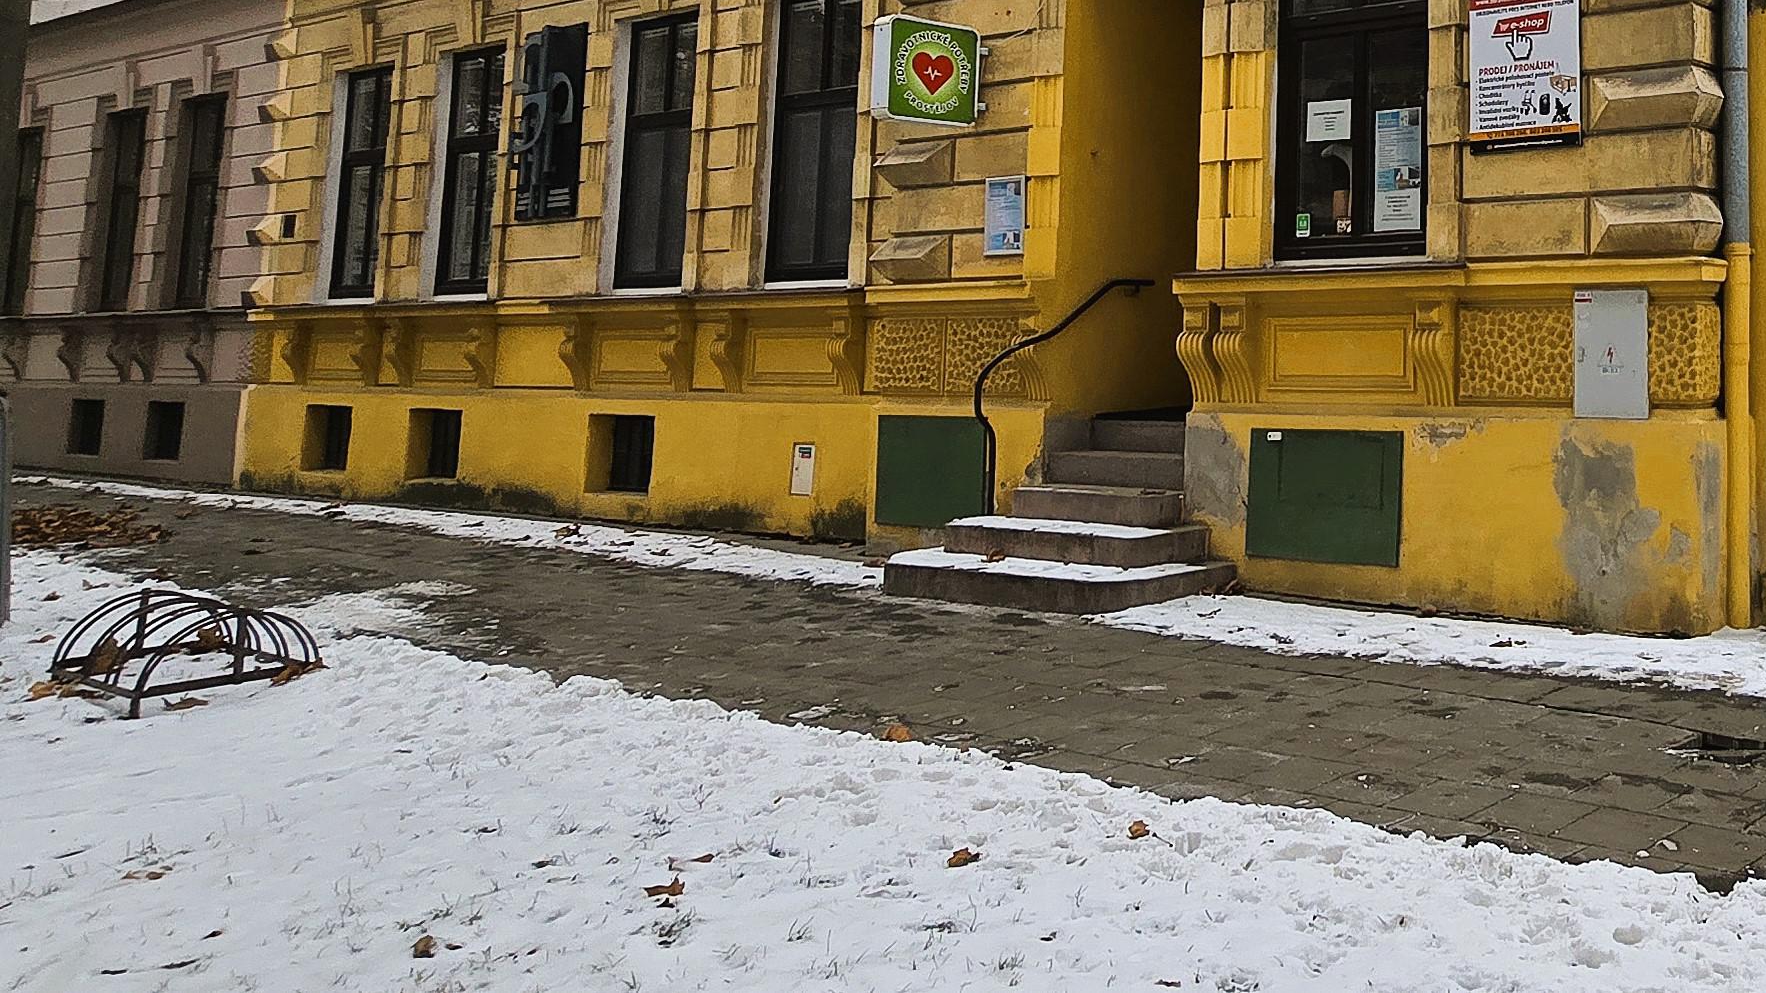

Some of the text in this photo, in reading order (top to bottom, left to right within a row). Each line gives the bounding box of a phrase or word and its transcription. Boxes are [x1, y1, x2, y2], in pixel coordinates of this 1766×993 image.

[1510, 18, 1544, 30] e-shop
[896, 32, 970, 93] ZDRAVOTNICKÉ POTŘEBY
[1479, 65, 1507, 76] PRODEJ
[1514, 60, 1554, 73] PRONÁJEM
[905, 91, 958, 113] PROSTĚJOV
